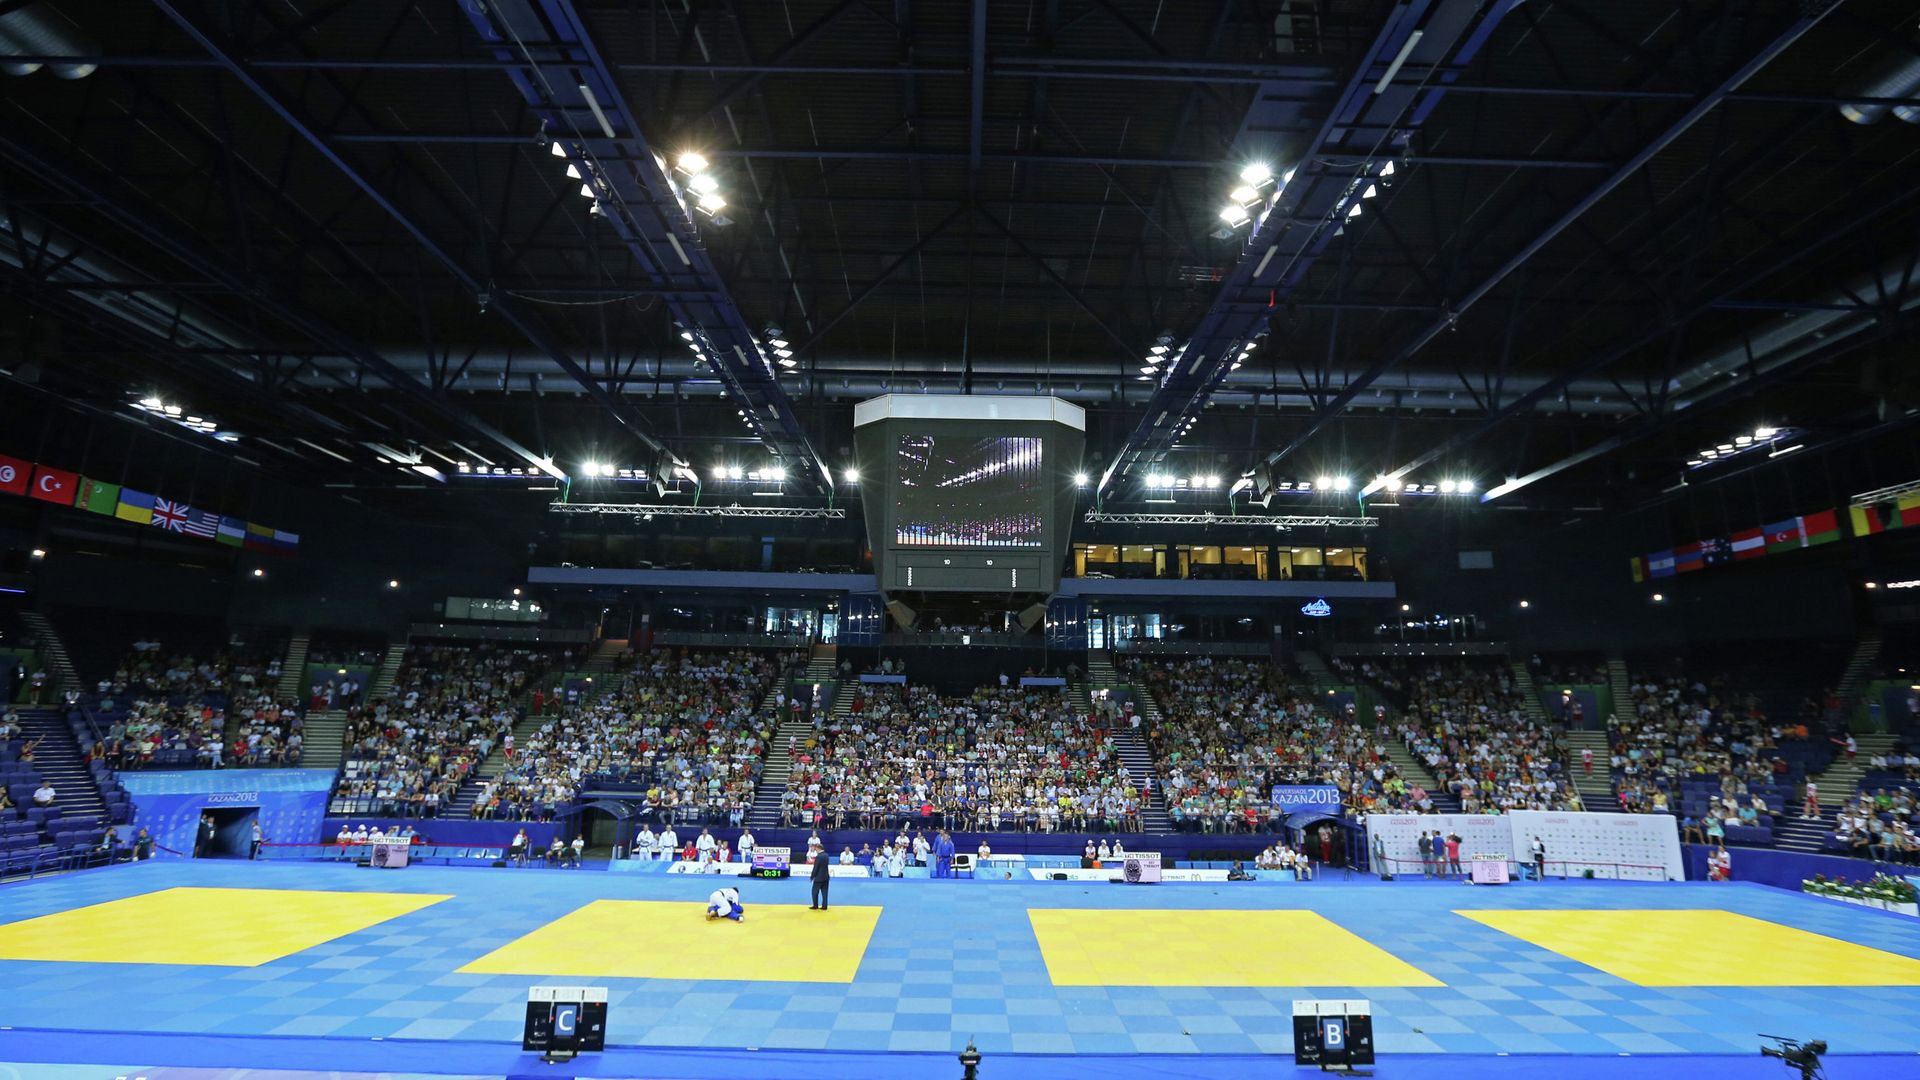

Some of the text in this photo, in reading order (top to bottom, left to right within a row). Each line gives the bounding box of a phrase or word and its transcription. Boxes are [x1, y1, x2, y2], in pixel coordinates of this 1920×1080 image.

[234, 791, 259, 802] 2013
[1272, 788, 1341, 804] KAZAN 2013
[763, 869, 781, 877] 0:31
[558, 1009, 573, 1031] C
[1327, 1023, 1342, 1045] B
